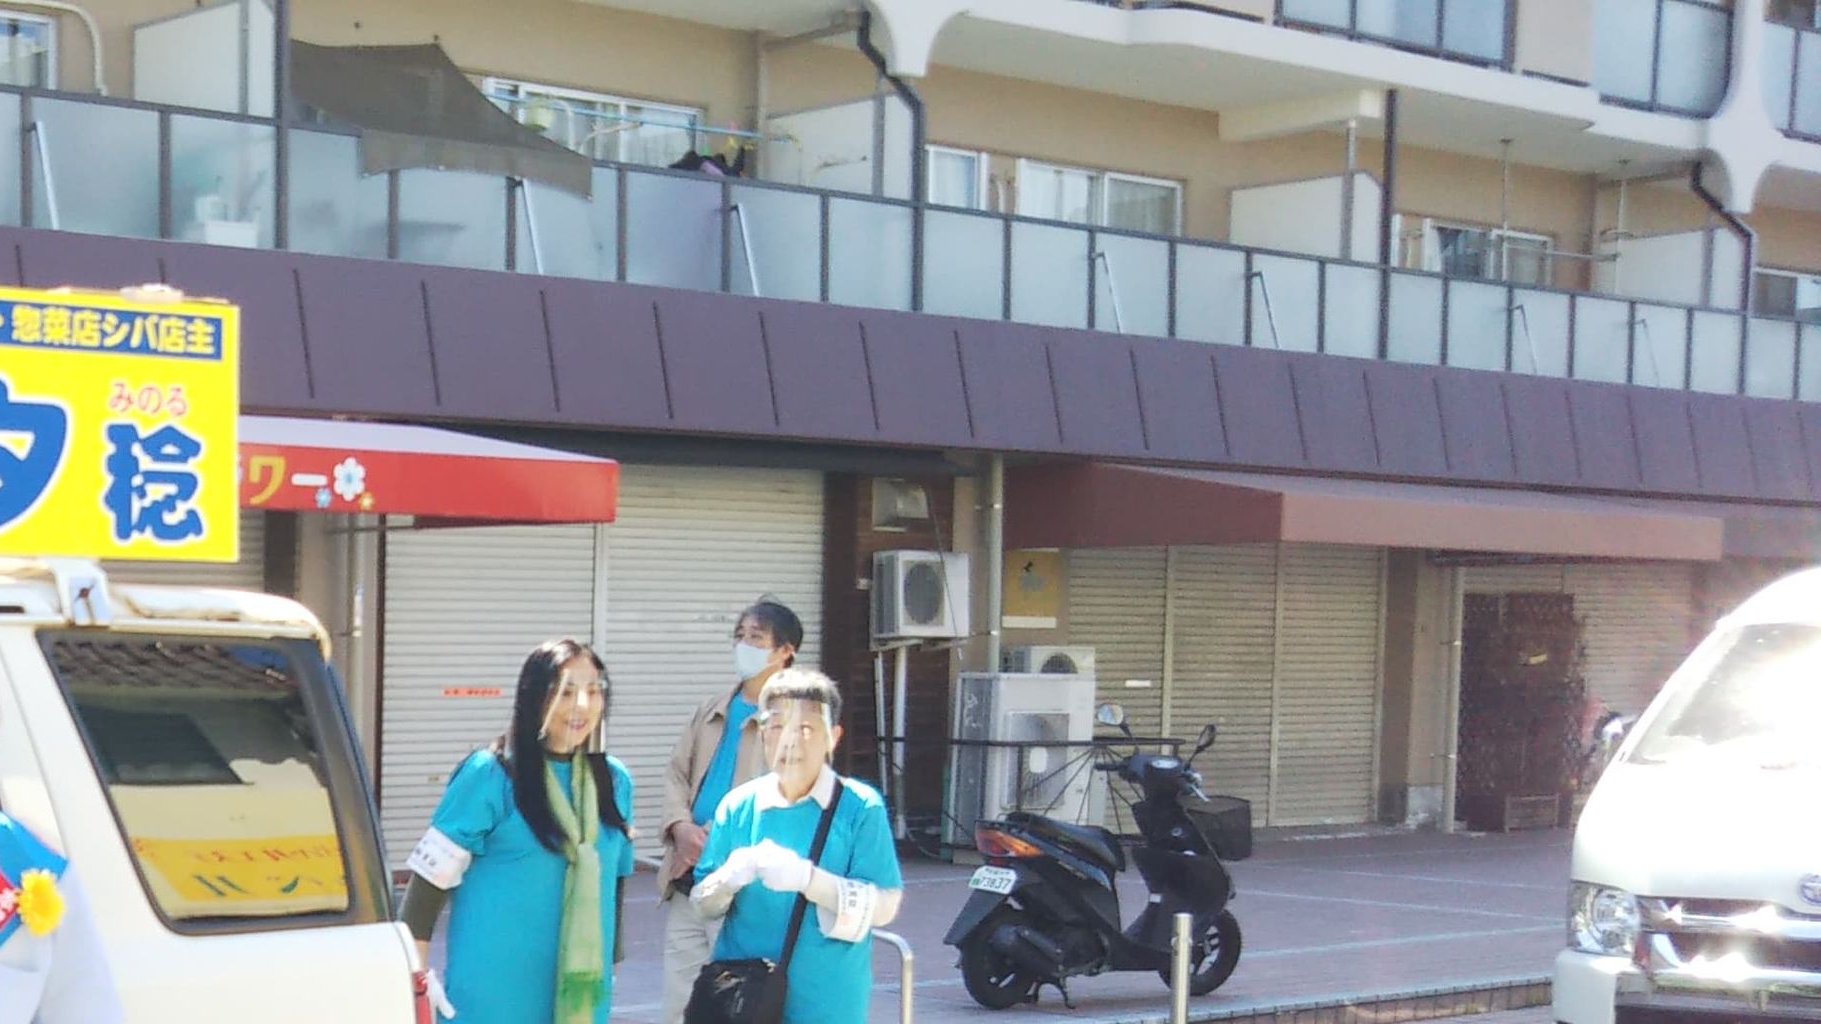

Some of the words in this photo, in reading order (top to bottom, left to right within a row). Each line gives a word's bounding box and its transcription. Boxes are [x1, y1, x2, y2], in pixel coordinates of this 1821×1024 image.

[109, 382, 188, 417] みのる
[105, 422, 203, 541] 稔
[237, 454, 328, 505] ワー
